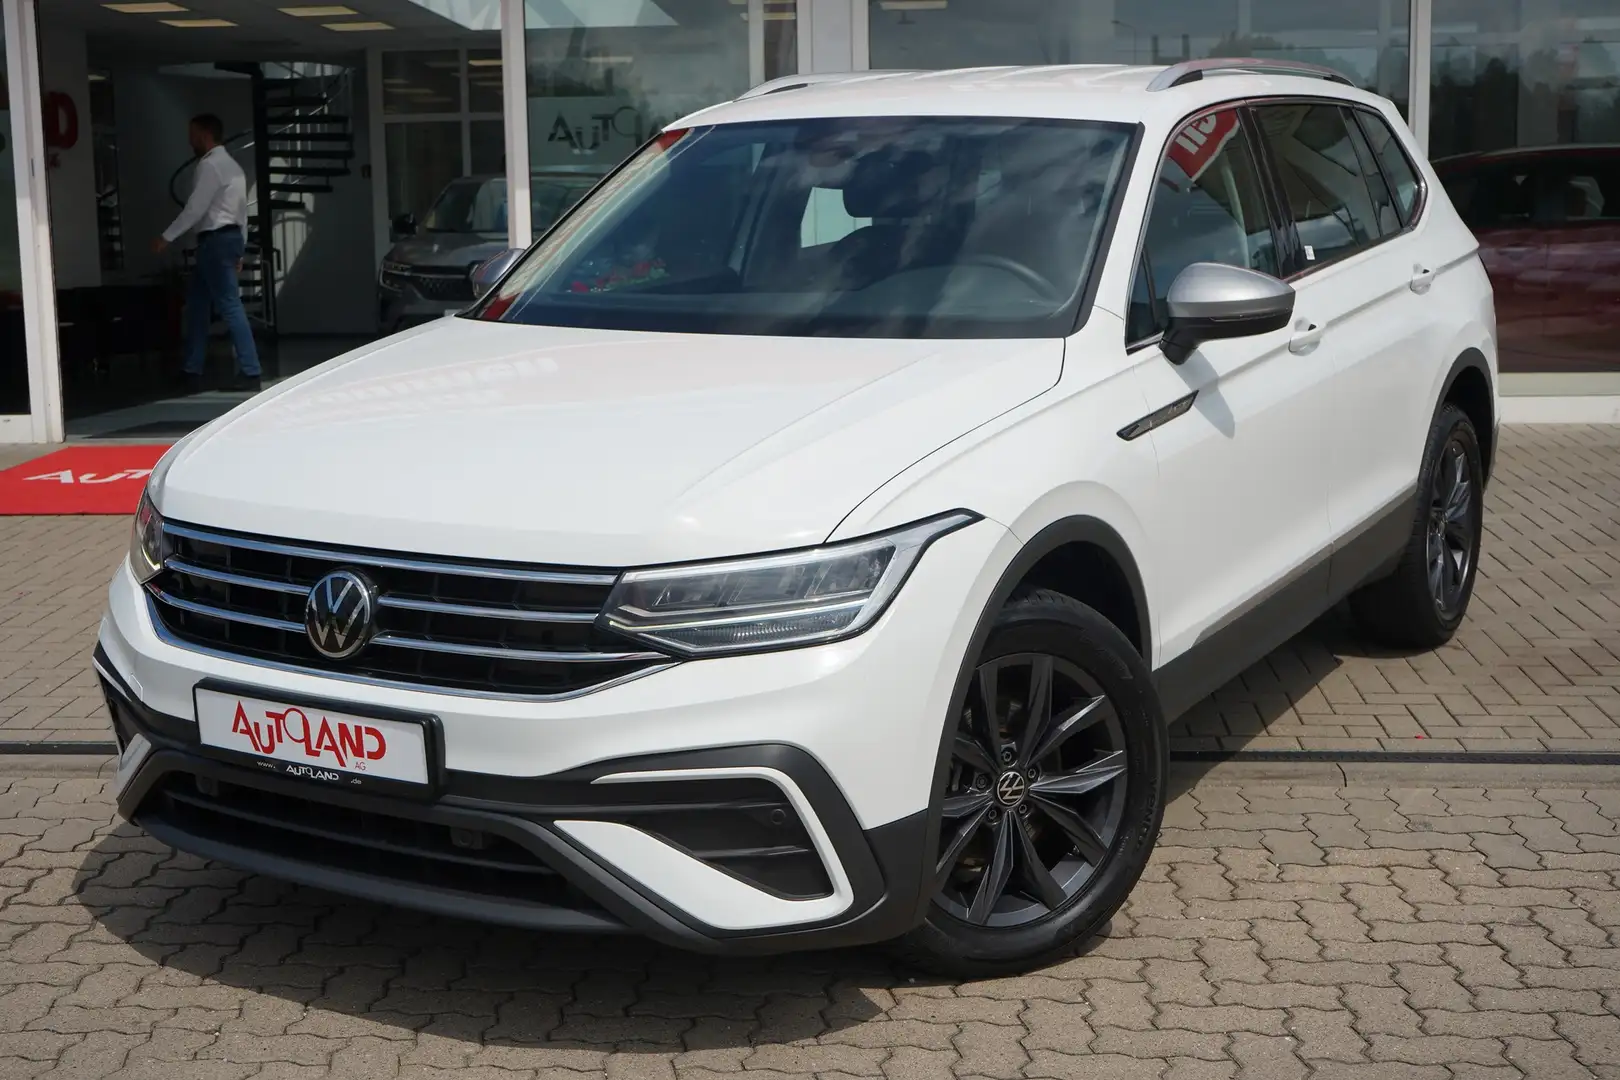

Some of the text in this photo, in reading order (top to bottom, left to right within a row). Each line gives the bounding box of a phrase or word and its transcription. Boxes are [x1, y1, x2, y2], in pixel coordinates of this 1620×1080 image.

[22, 469, 152, 483] AUT
[232, 701, 387, 767] AUTOLAND
[286, 765, 340, 781] AUTOLAND
[354, 761, 367, 771] AG
